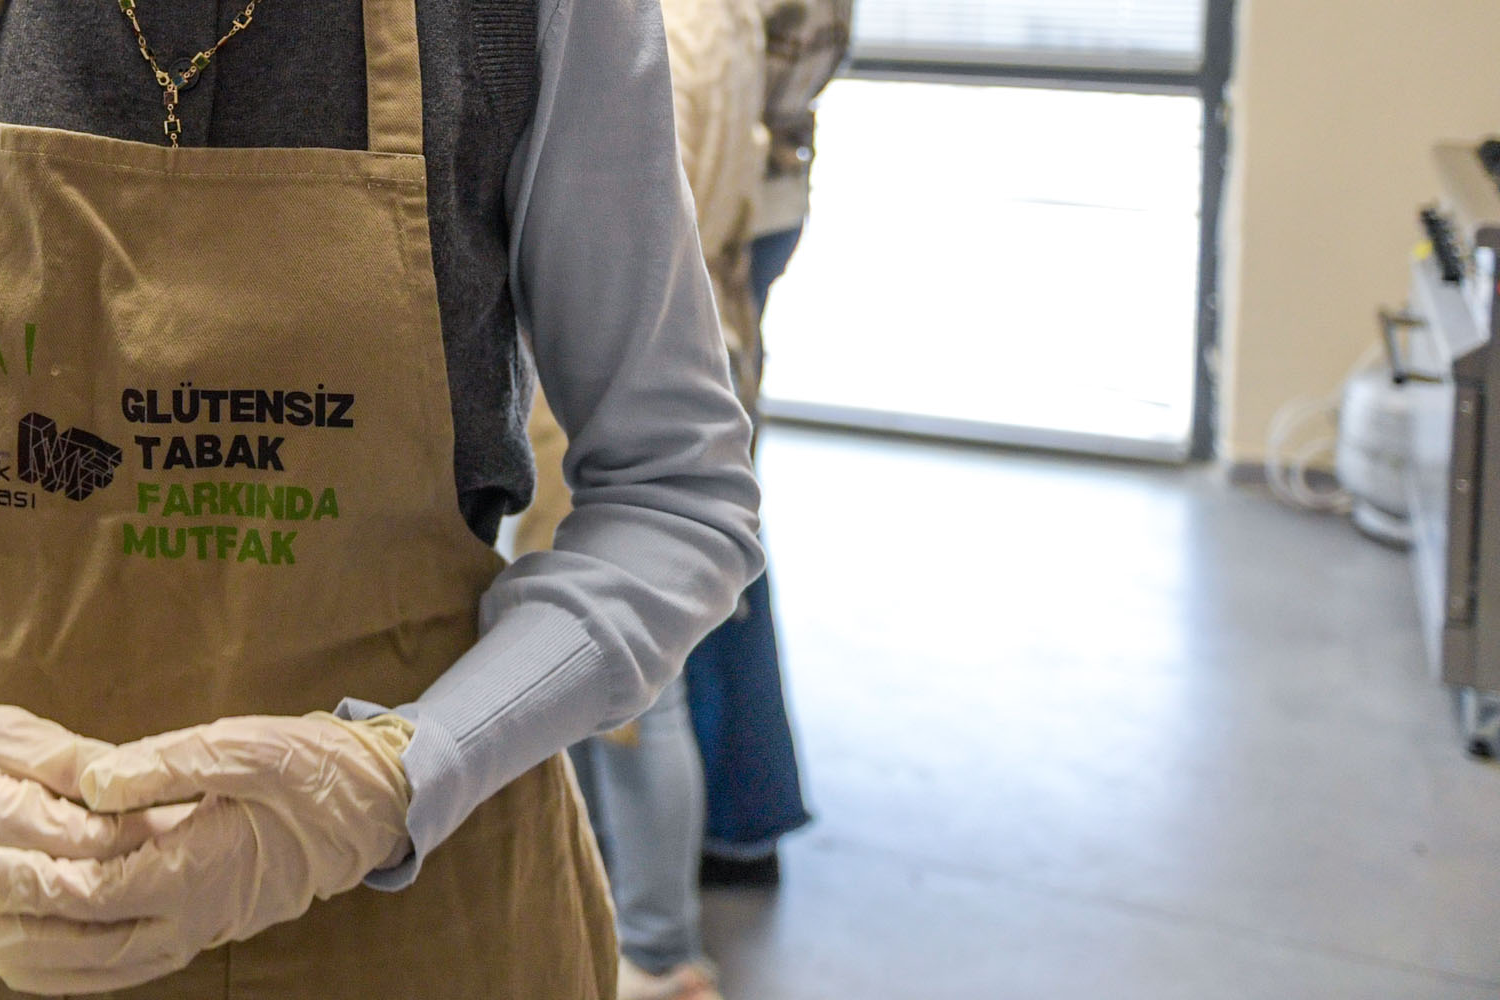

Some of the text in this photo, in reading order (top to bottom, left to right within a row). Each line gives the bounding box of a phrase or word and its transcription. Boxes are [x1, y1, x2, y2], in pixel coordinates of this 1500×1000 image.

[121, 381, 355, 428] GLÜTENSİZ
[134, 435, 285, 471] TABAK
[136, 481, 340, 521] FARKINDA
[122, 523, 298, 565] MUTFAK
